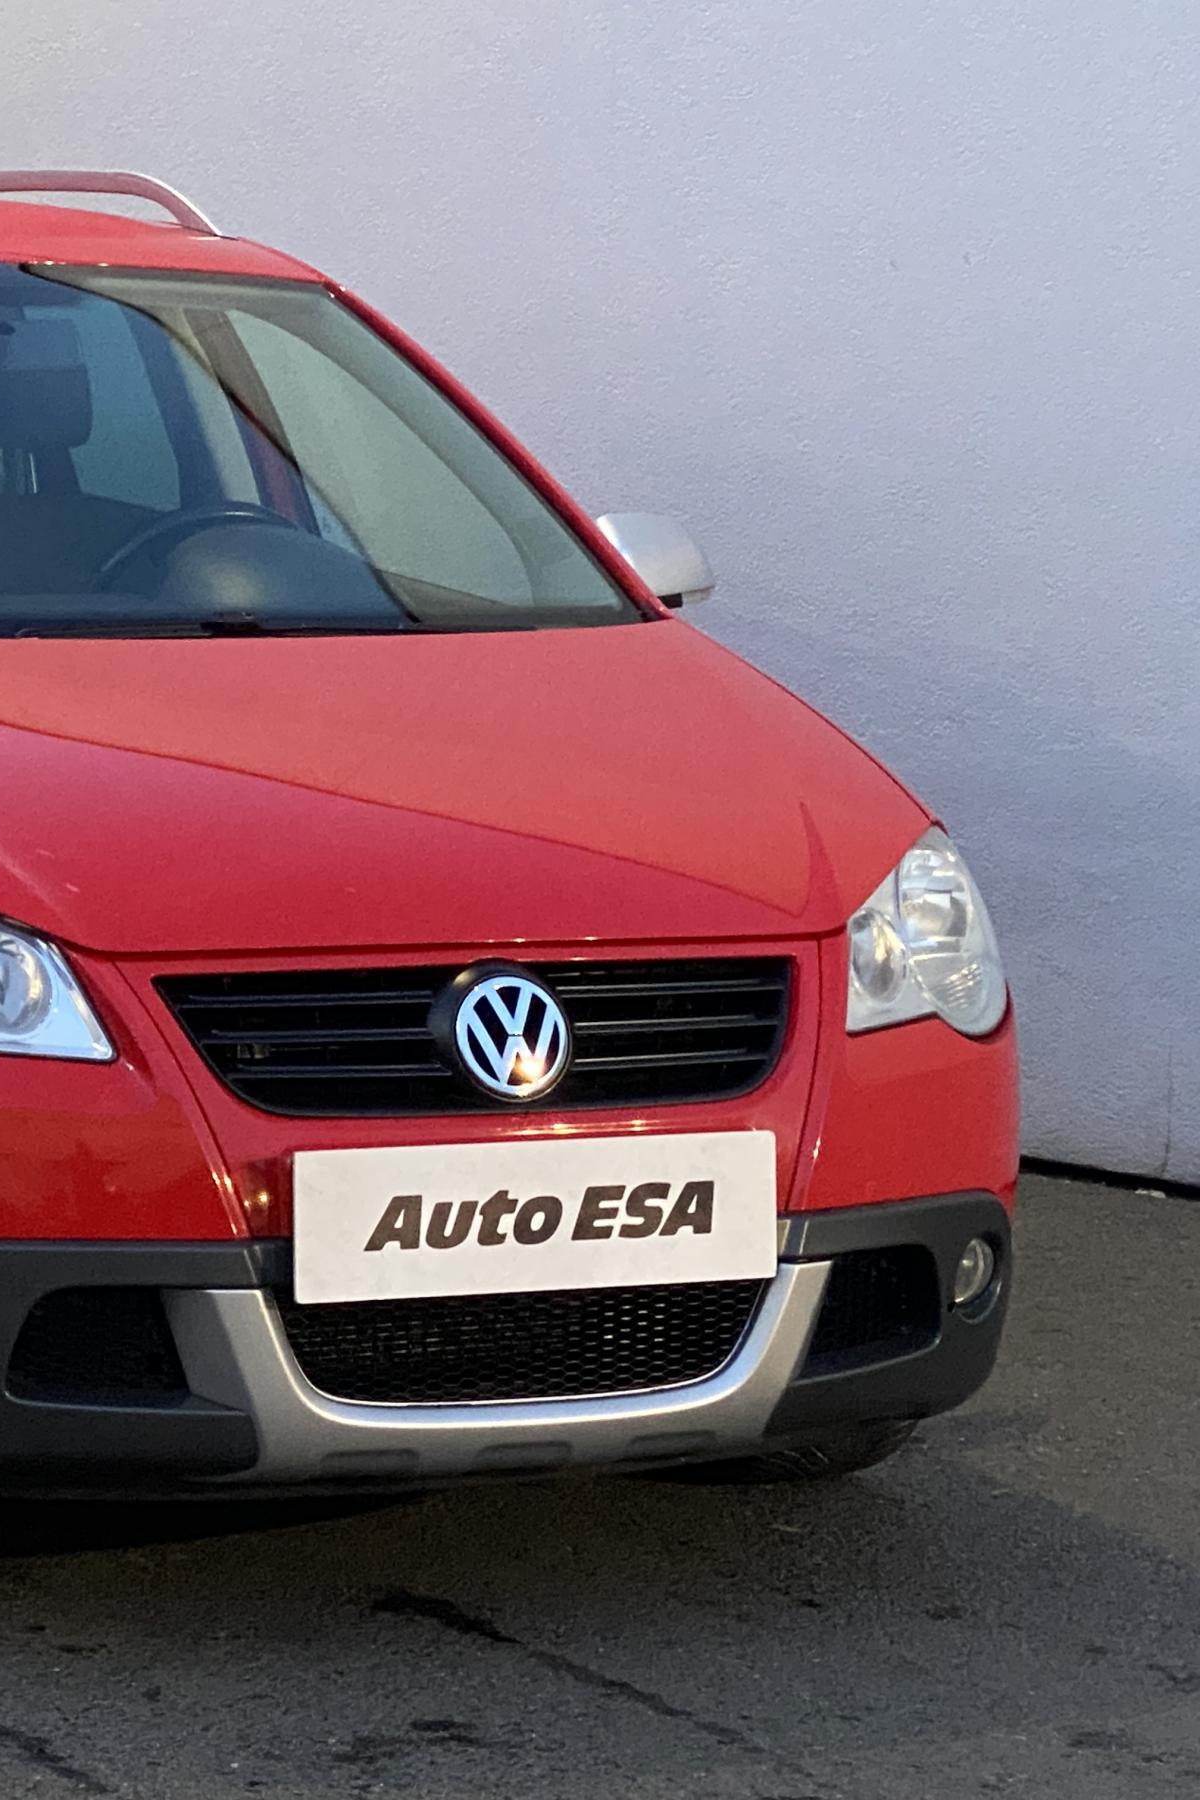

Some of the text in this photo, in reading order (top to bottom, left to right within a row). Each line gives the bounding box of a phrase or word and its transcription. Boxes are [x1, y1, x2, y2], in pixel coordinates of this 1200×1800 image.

[456, 976, 566, 1096] VW
[364, 1180, 715, 1252] Auto ESA
